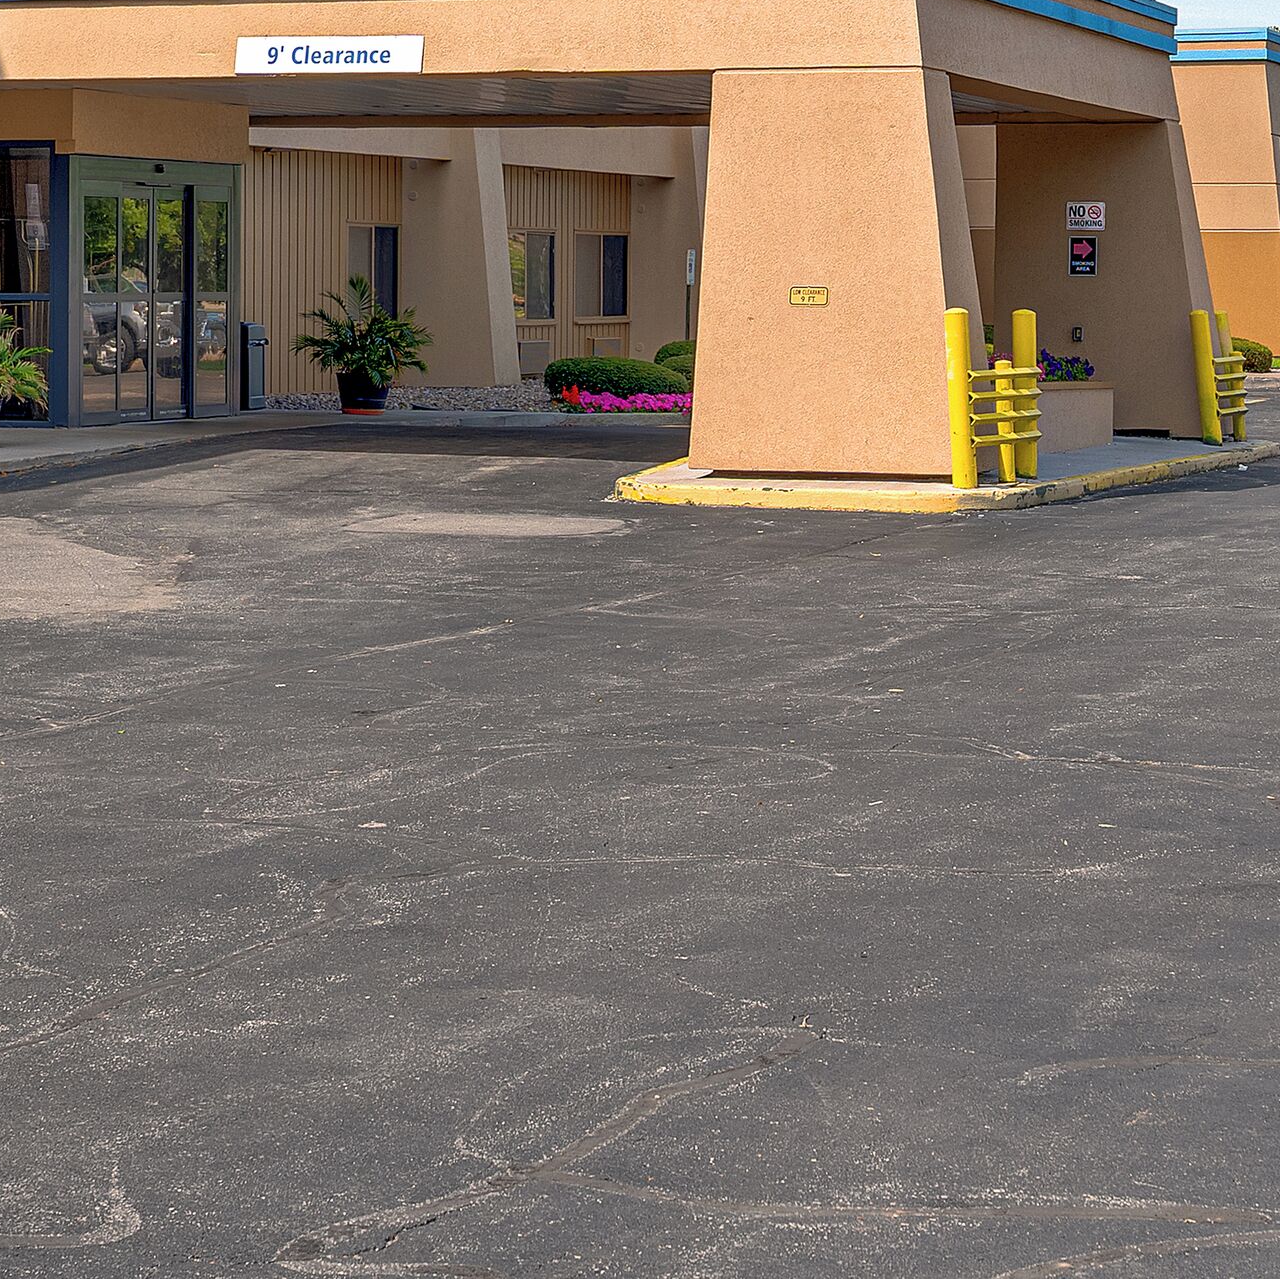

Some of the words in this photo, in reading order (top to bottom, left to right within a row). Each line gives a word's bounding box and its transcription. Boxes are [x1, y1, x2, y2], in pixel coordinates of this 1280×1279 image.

[267, 45, 284, 64] 9'
[291, 45, 391, 64] Clearance
[1068, 205, 1086, 218] NO
[1069, 219, 1103, 227] SMOKING
